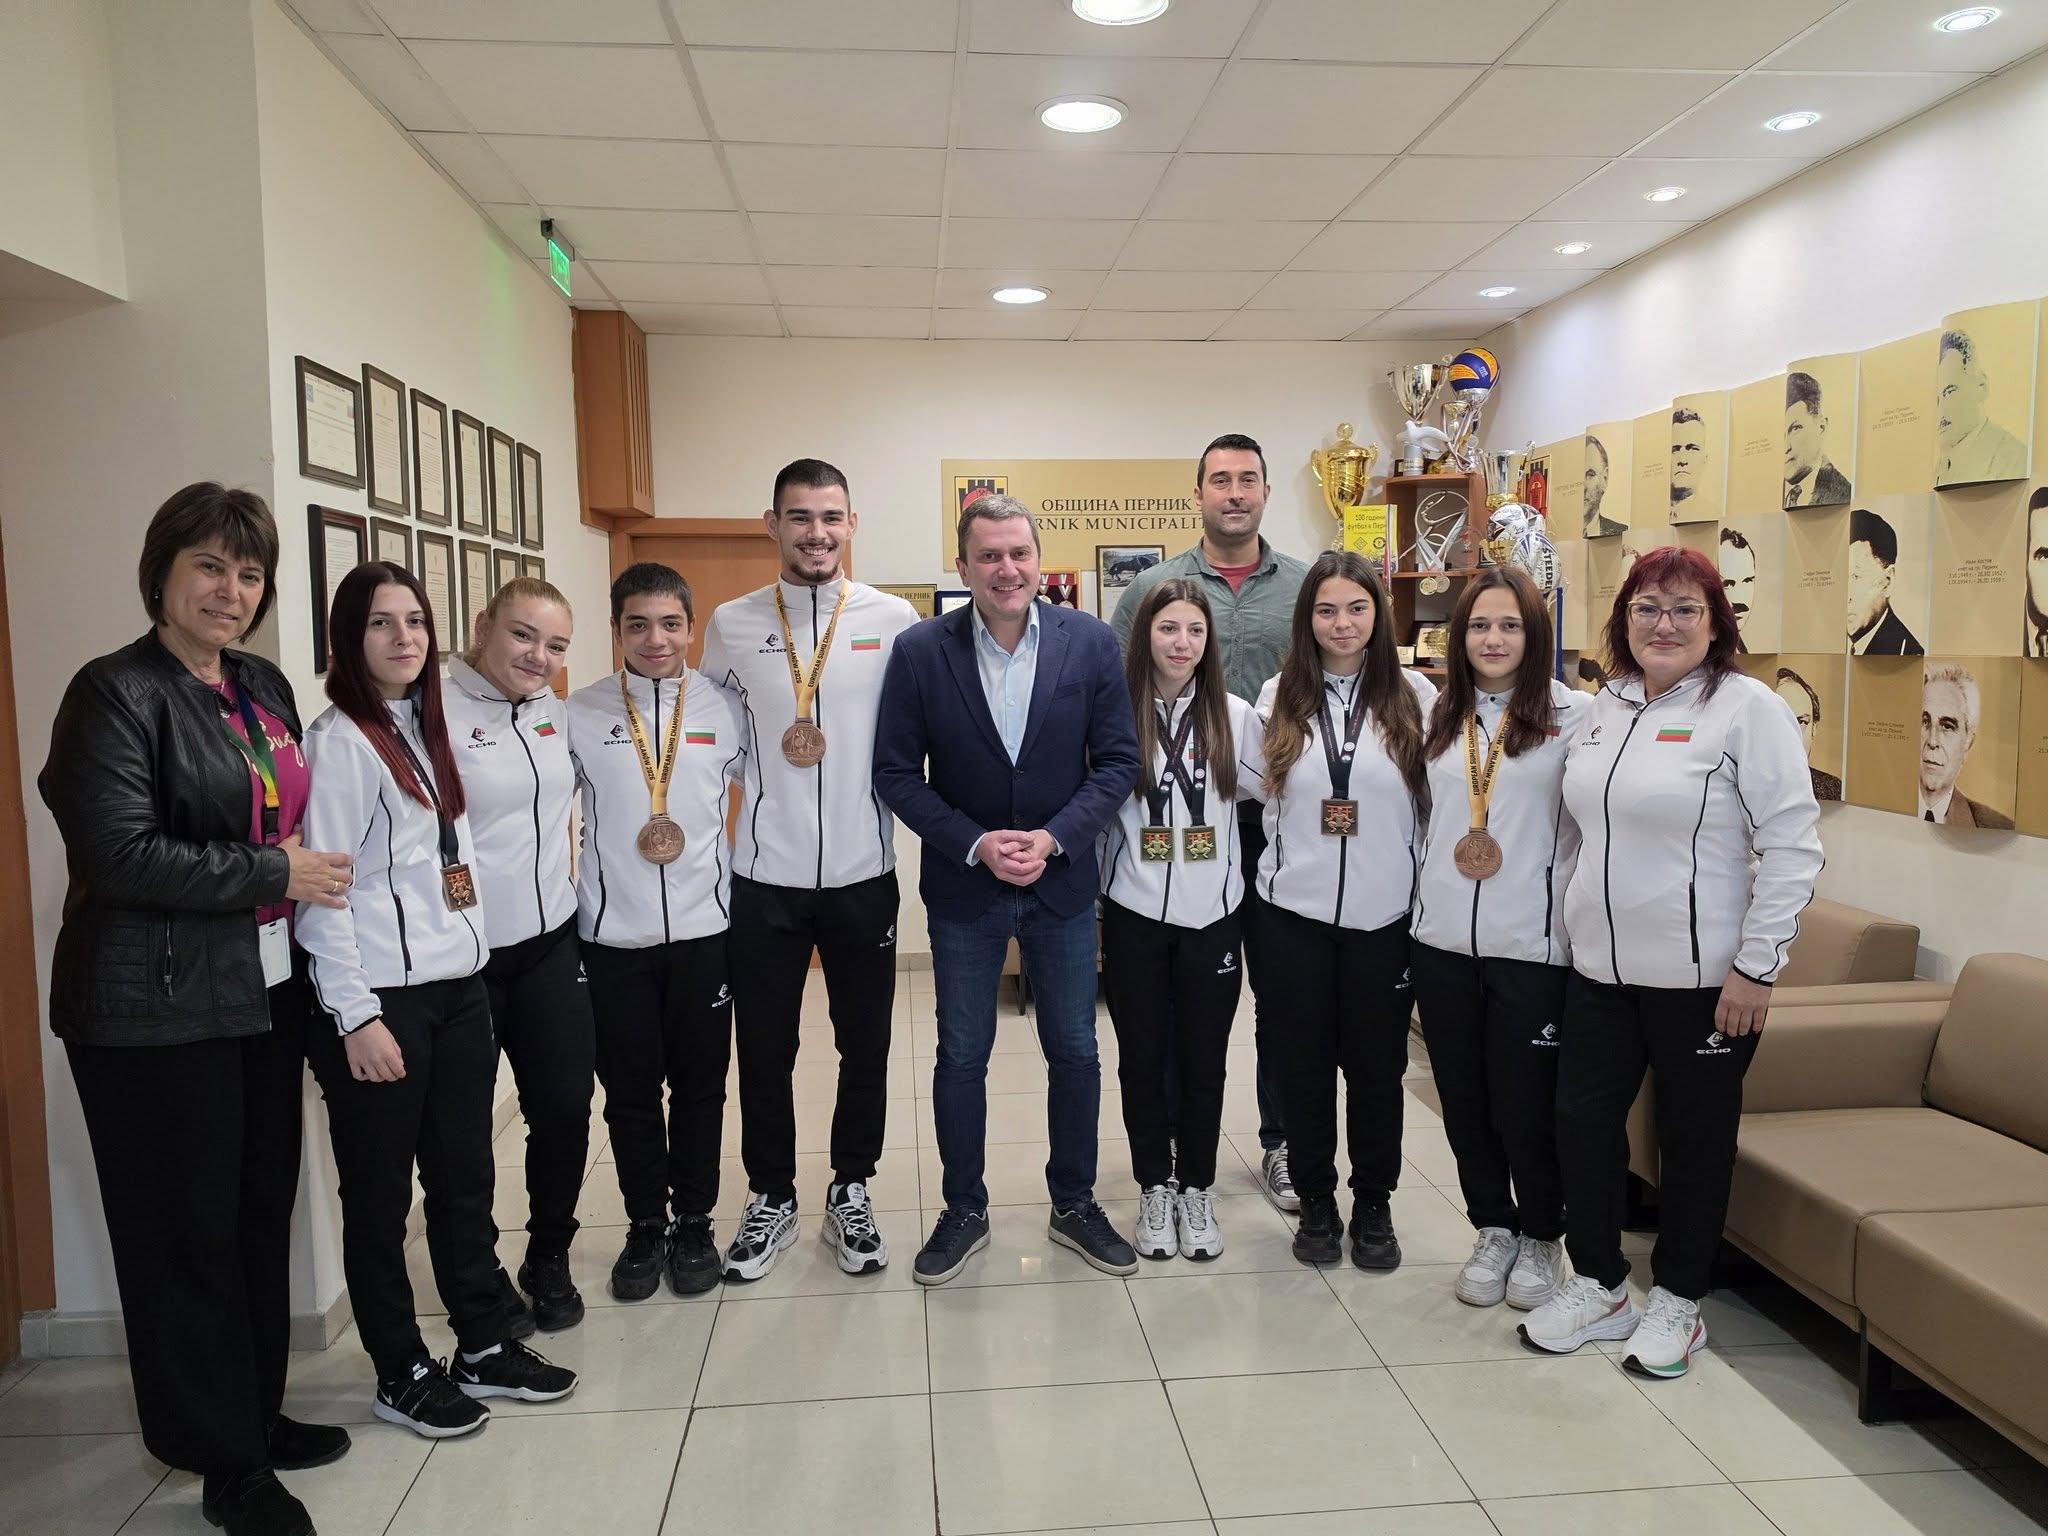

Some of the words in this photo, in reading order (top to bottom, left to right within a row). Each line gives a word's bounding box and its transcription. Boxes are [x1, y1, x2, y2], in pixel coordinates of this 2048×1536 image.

[1042, 499, 1119, 514] ОБЩИНА
[1125, 498, 1192, 511] ПЕРНИК
[1035, 518, 1079, 530] RNIK
[1086, 517, 1205, 530] MUNICIPALIT
[1542, 547, 1554, 589] STEEDE
[807, 658, 822, 688] EUROPEAN
[816, 642, 827, 659] SUMO
[468, 741, 496, 749] ECHO
[1468, 748, 1476, 764] SUMO
[659, 753, 672, 783] EUROPEAN
[666, 736, 675, 753] SUMO
[1470, 765, 1479, 795] EUROPEAN
